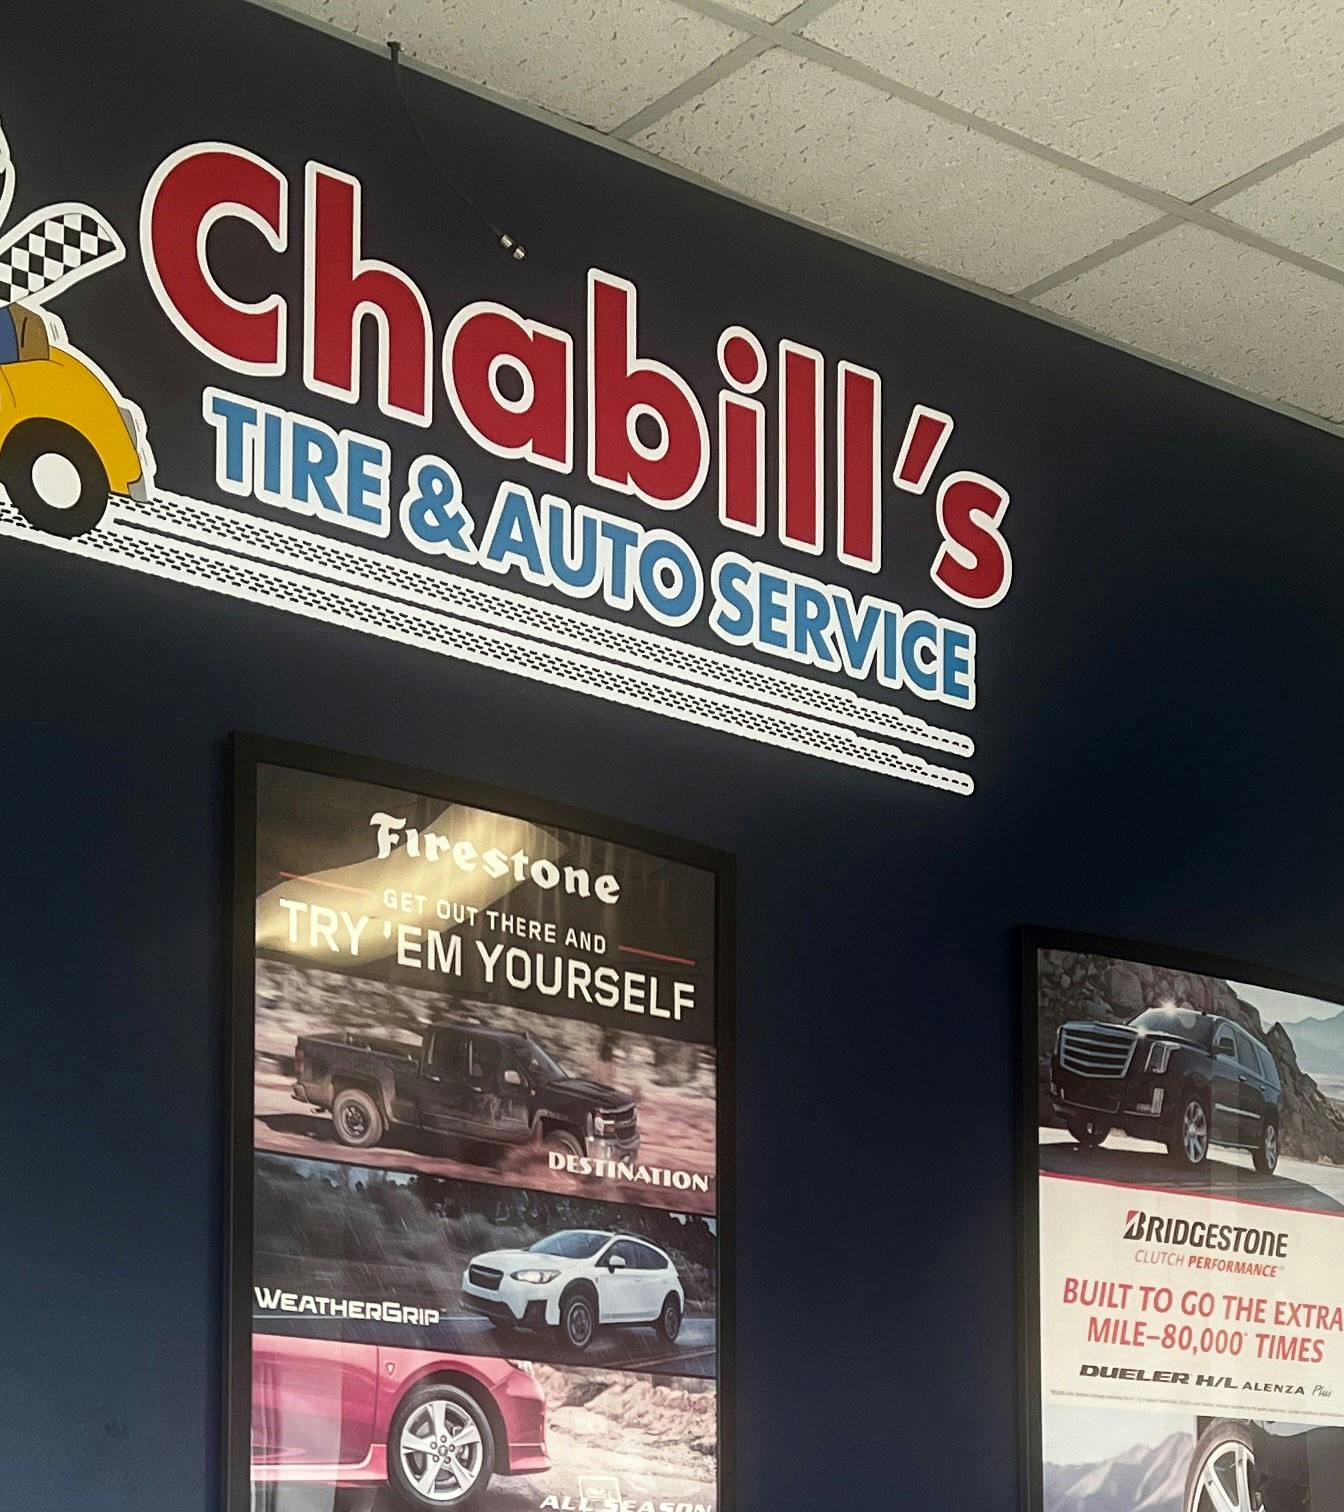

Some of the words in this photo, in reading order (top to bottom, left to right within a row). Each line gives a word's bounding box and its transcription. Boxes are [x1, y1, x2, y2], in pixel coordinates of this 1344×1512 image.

[139, 141, 1013, 609] Chabill's
[203, 387, 391, 538] TIRE
[406, 455, 479, 554] &
[486, 481, 706, 629] AUTO
[709, 553, 976, 710] SERVICE
[370, 812, 621, 905] Firestone
[383, 888, 428, 916] GET
[436, 898, 479, 928] OUT
[487, 910, 557, 944] THERE
[565, 926, 608, 955] AND
[279, 898, 369, 956] TRY
[383, 922, 462, 977] 'EM
[475, 940, 696, 1021] YOURSELF
[548, 1151, 709, 1193] DESTINATION
[1123, 1210, 1289, 1258] BRIDGESTONE
[1134, 1249, 1185, 1267] CLUTCH
[1187, 1255, 1279, 1278] PERFORMANCE
[1063, 1277, 1133, 1310] BUILT
[1139, 1285, 1173, 1314] TO
[1181, 1290, 1215, 1318] GO
[1222, 1294, 1267, 1324] THE
[1274, 1300, 1344, 1332] EXTRA
[1255, 1333, 1325, 1364] TIMES
[1079, 1364, 1191, 1386] DUELER
[1195, 1374, 1238, 1390] H/L
[1242, 1381, 1306, 1395] ALENZA
[539, 1495, 594, 1512] ALL
